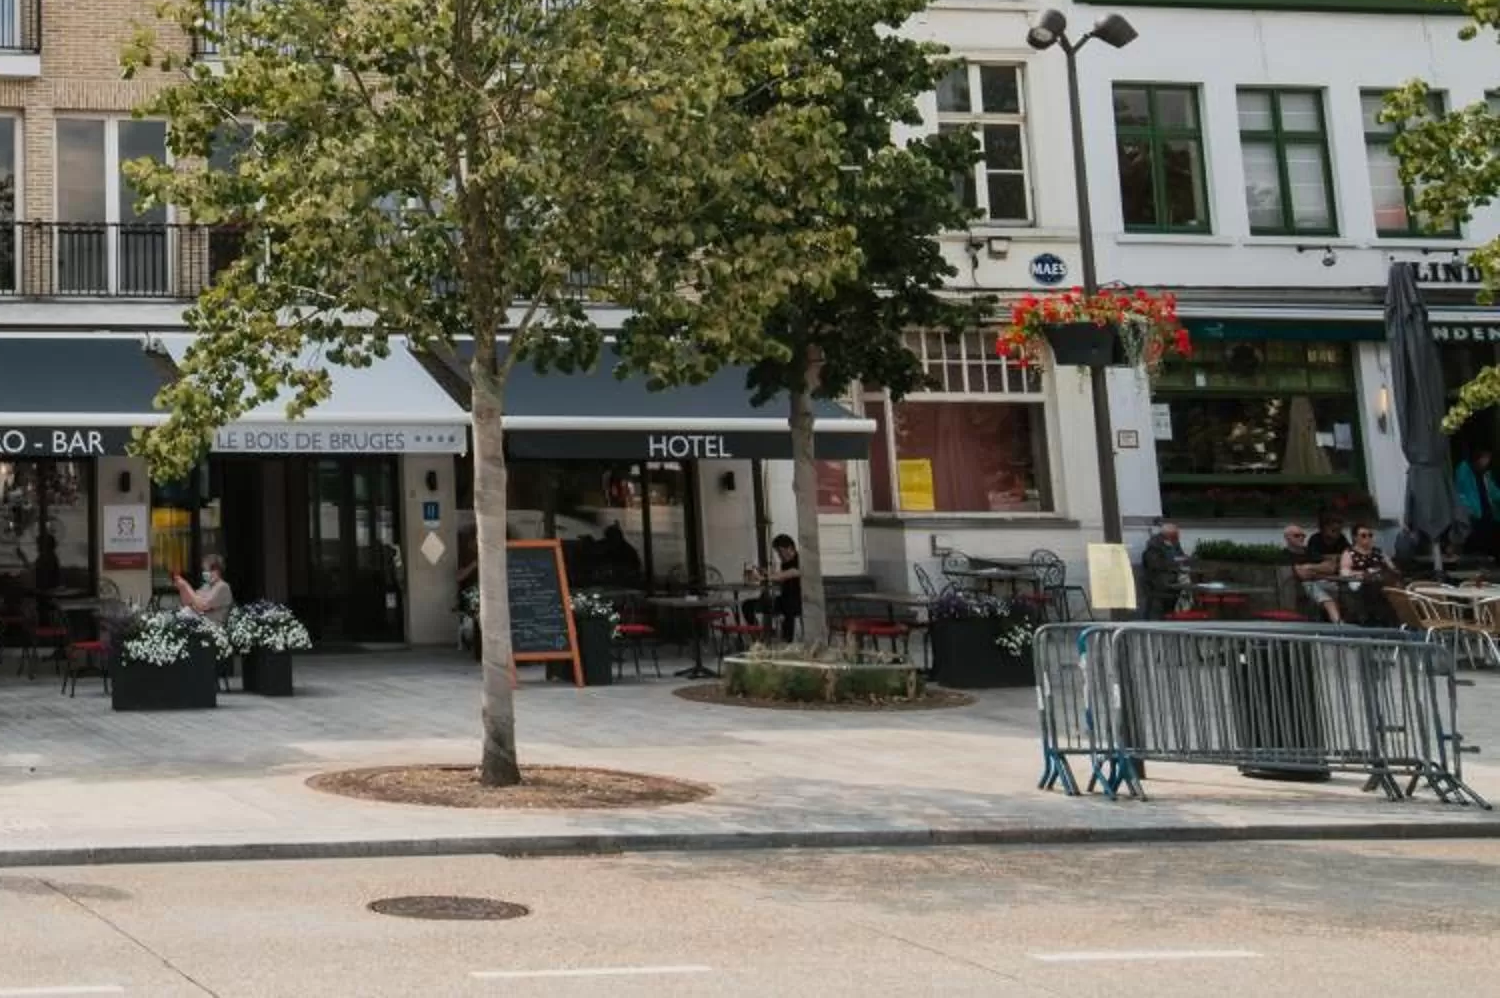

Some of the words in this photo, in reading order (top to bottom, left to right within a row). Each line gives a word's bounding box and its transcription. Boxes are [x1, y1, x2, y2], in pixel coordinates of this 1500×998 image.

[1031, 262, 1067, 275] MAES
[1411, 262, 1483, 283] LIND
[1431, 326, 1500, 341] NDEN
[52, 429, 104, 454] BAR
[217, 432, 238, 450] LE
[244, 432, 290, 450] BOIS
[296, 432, 321, 451] DE
[330, 432, 405, 451] BRUGES
[649, 434, 732, 458] HOTEL
